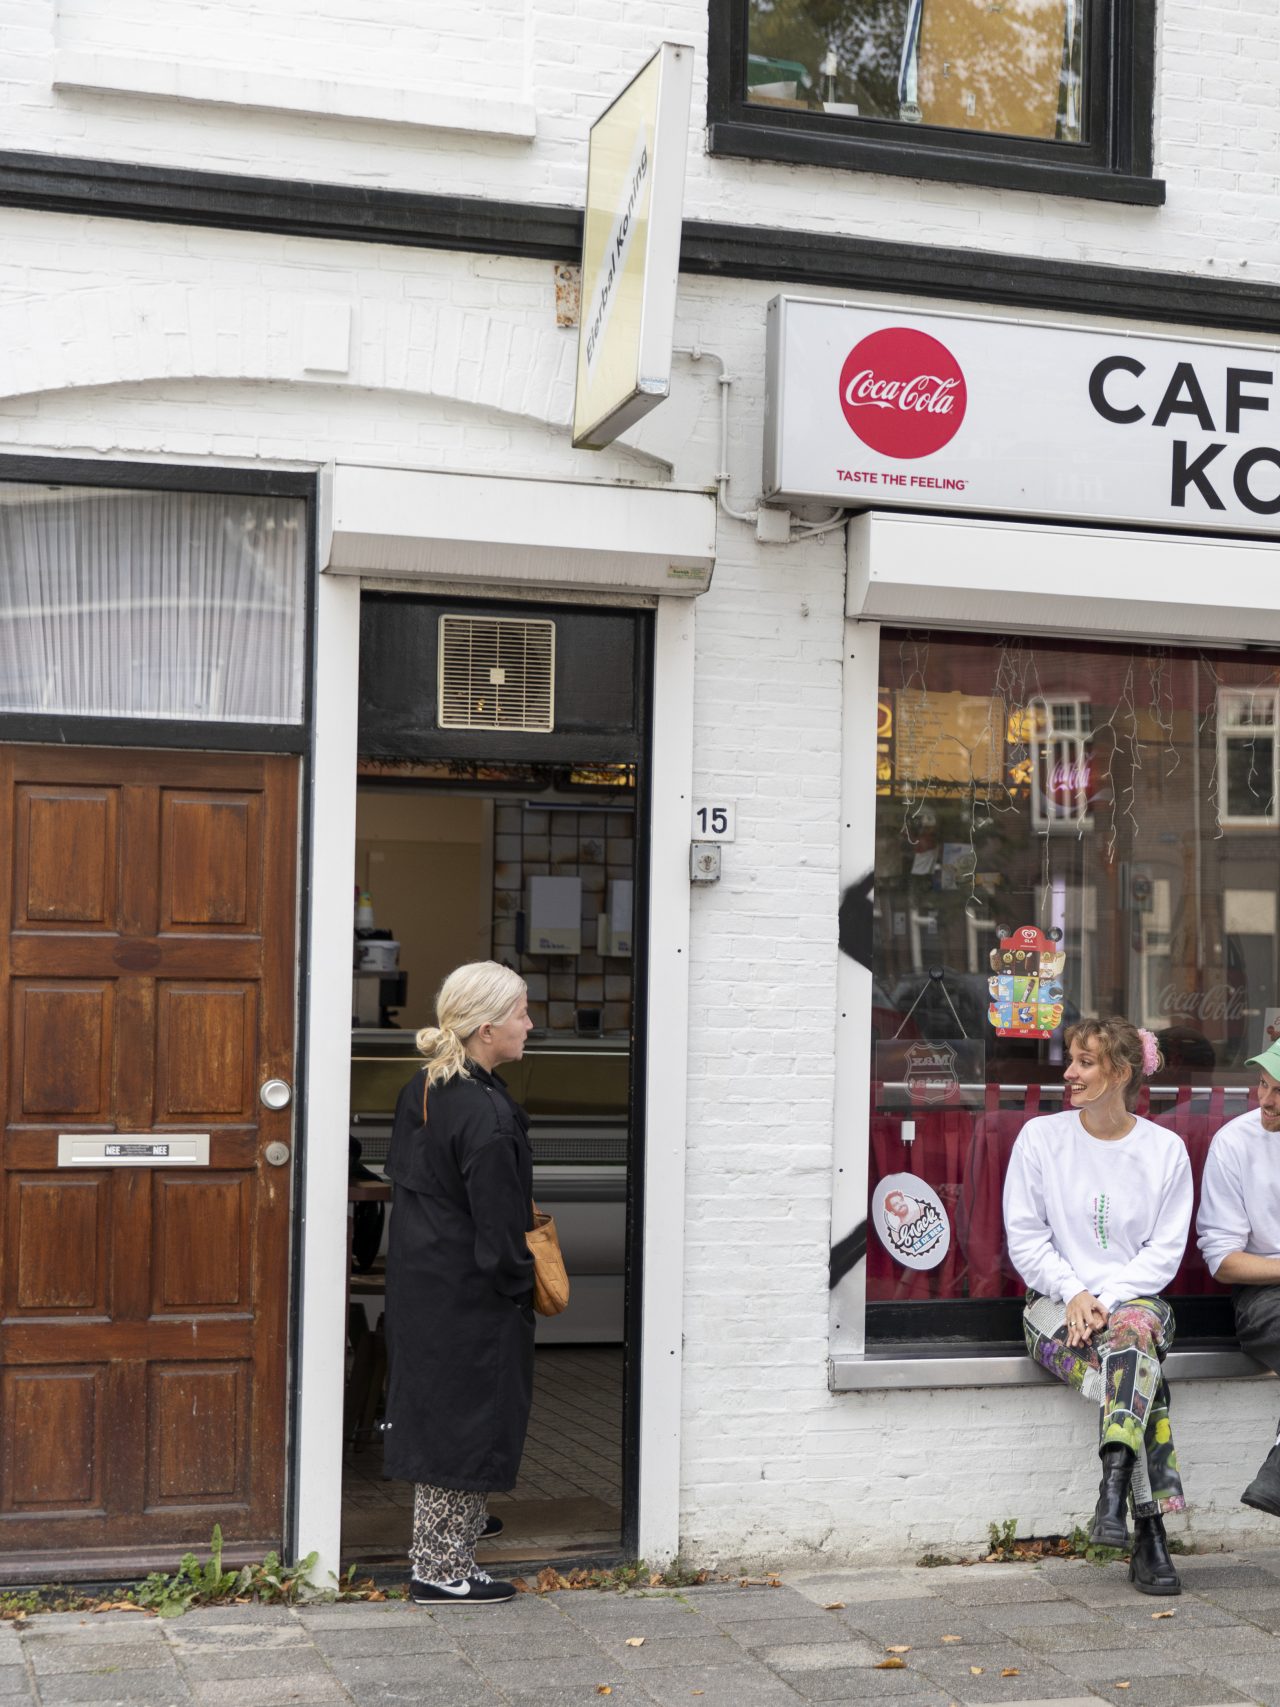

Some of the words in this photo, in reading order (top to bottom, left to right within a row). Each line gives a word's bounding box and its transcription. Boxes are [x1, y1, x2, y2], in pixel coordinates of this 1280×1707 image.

[615, 144, 648, 259] Koning
[846, 369, 961, 415] Coca-Cola
[836, 470, 878, 484] TASTE
[881, 473, 907, 486] THE
[696, 807, 728, 834] 15
[1157, 983, 1247, 1021] Coca-Cola
[106, 1145, 121, 1155] NEE
[153, 1145, 167, 1155] NEE
[897, 1206, 938, 1247] Snack
[913, 1241, 922, 1251] IN
[922, 1233, 932, 1244] DE
